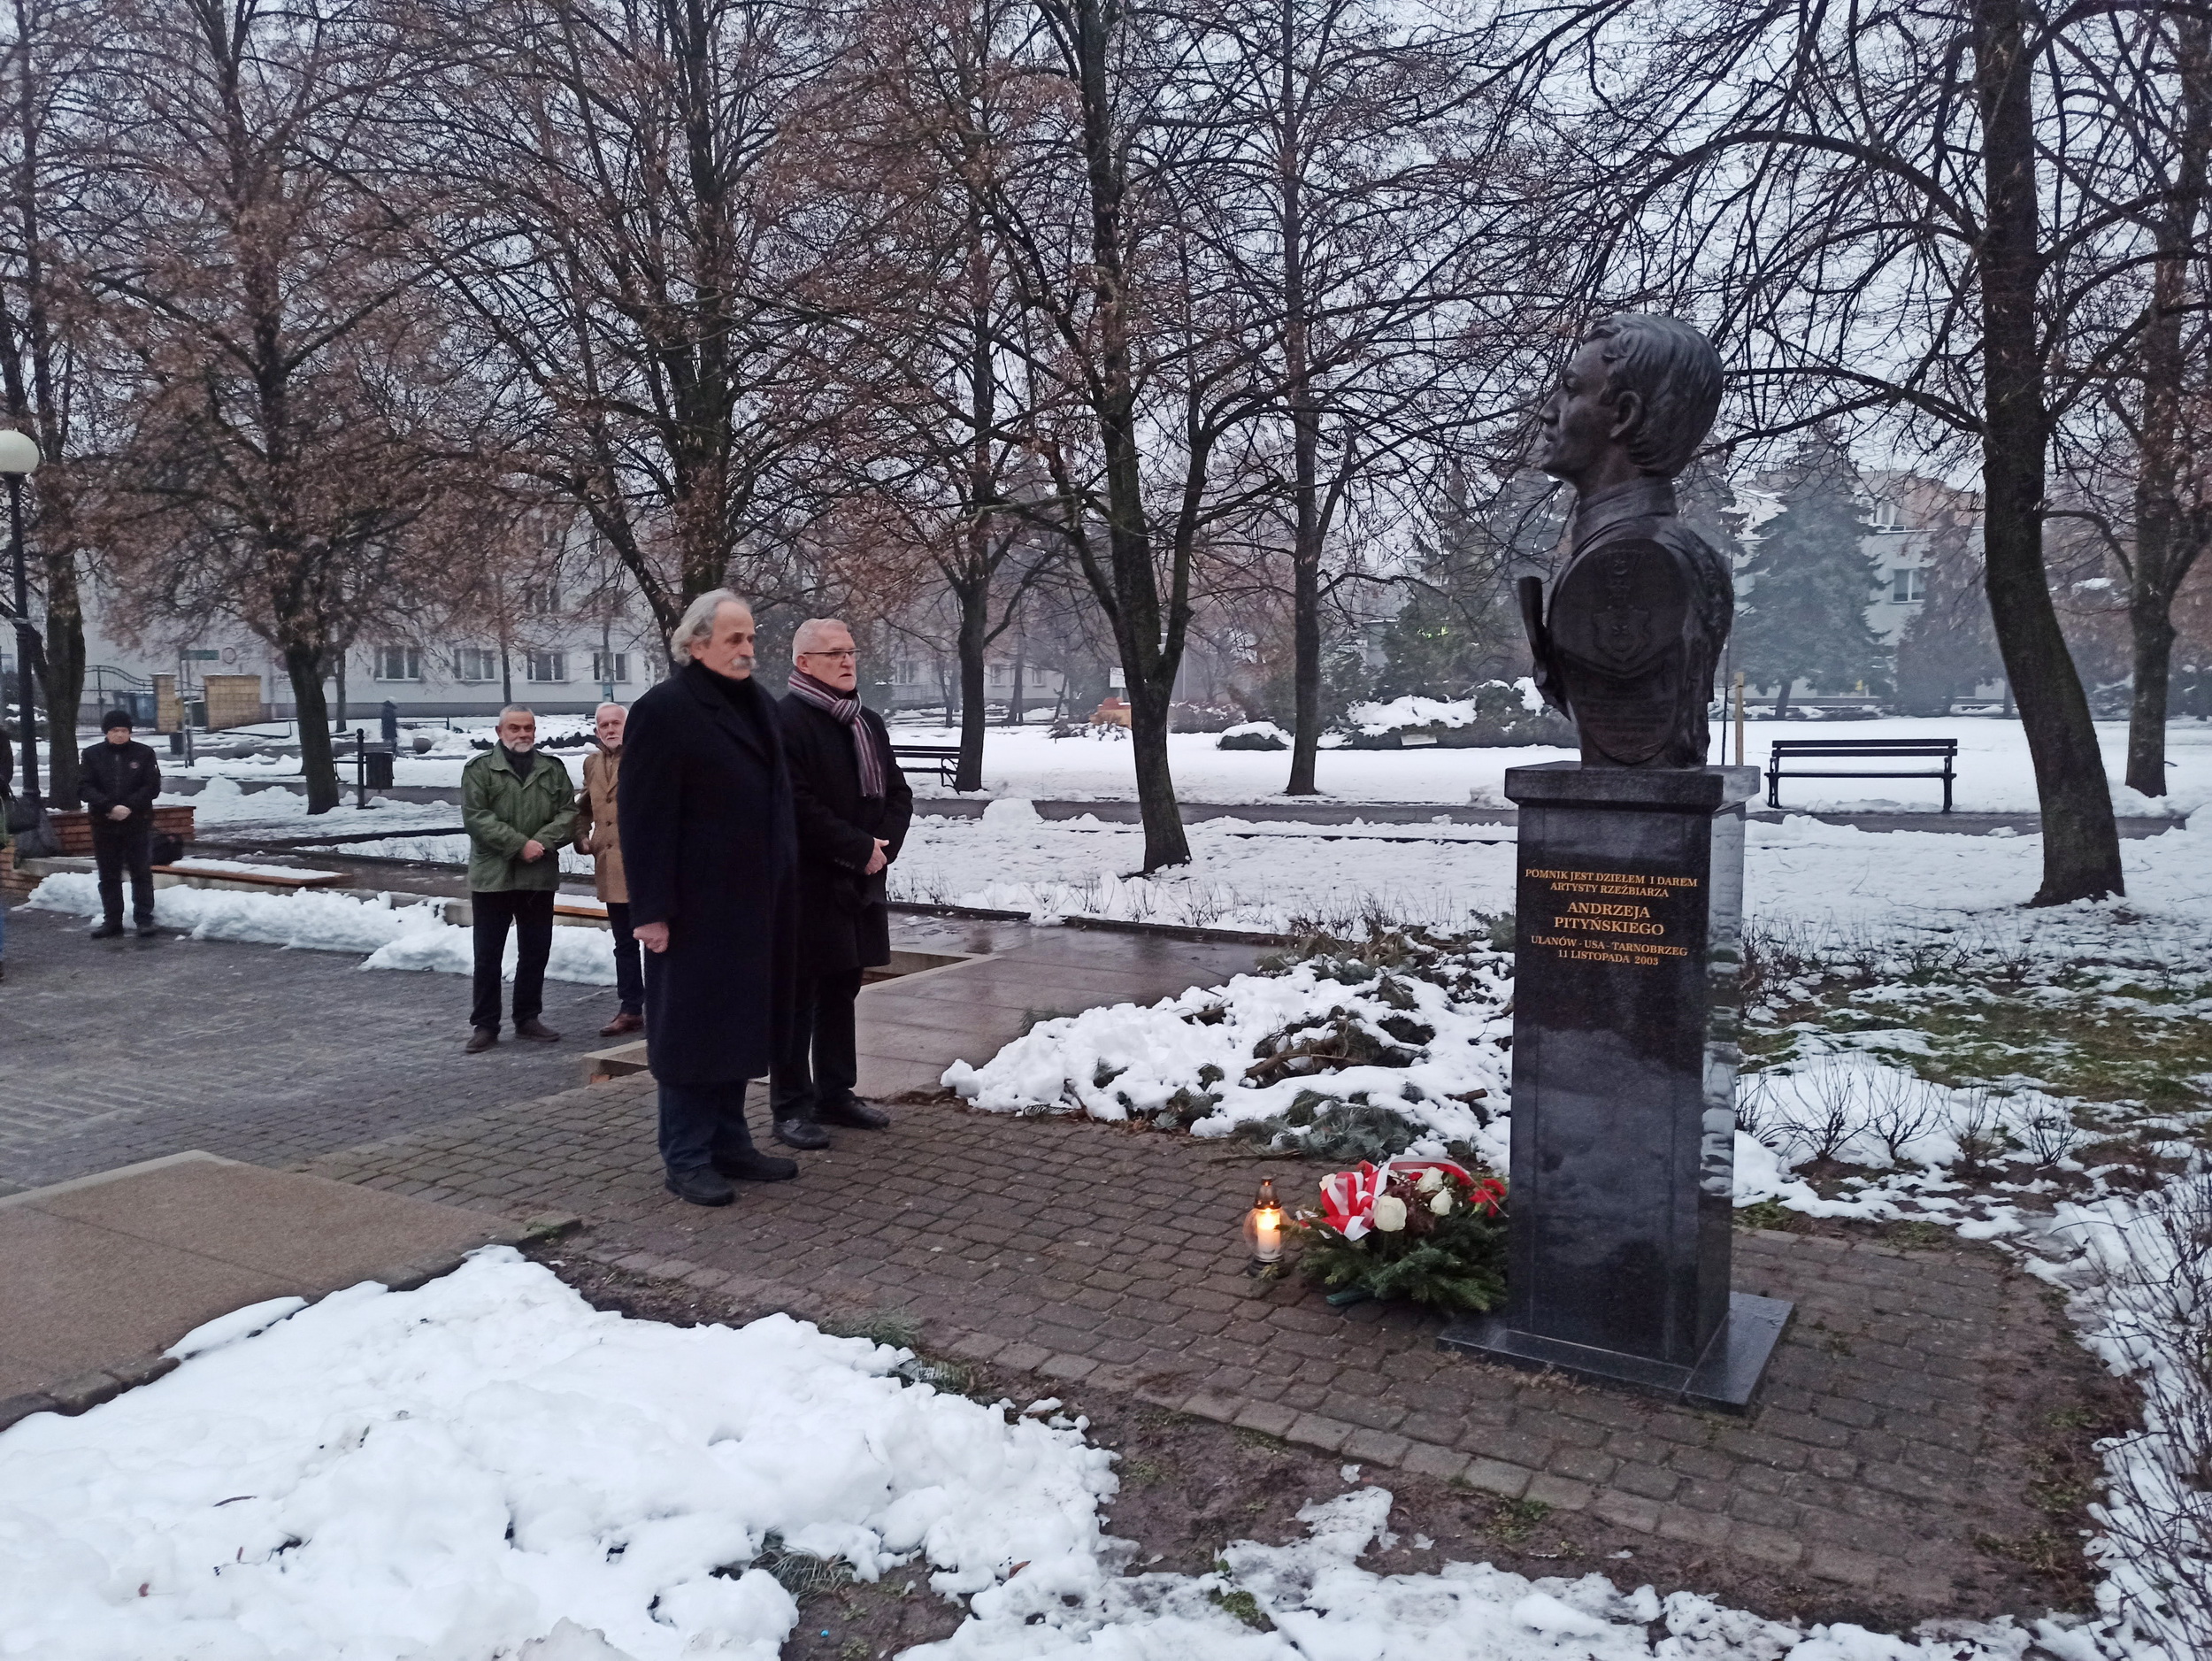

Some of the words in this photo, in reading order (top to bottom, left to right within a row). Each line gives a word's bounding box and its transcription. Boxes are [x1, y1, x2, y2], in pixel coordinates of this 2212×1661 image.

[1525, 869, 1568, 880] POMNIK
[1571, 872, 1594, 881] JEST
[1596, 873, 1645, 883] DZIEŁEM
[1657, 877, 1697, 887] DAREM
[1550, 882, 1597, 892] ARTYSTY
[1601, 884, 1669, 897] RZEŹBIARZA
[1567, 902, 1650, 919] ANDRZEJA
[1554, 917, 1663, 935] PITYŃSKIEGO
[1531, 935, 1577, 947] ULANÓW
[1612, 942, 1687, 956] TARNOBRZEG
[1571, 951, 1630, 964] LISTOPADA
[1634, 956, 1658, 965] 2003
